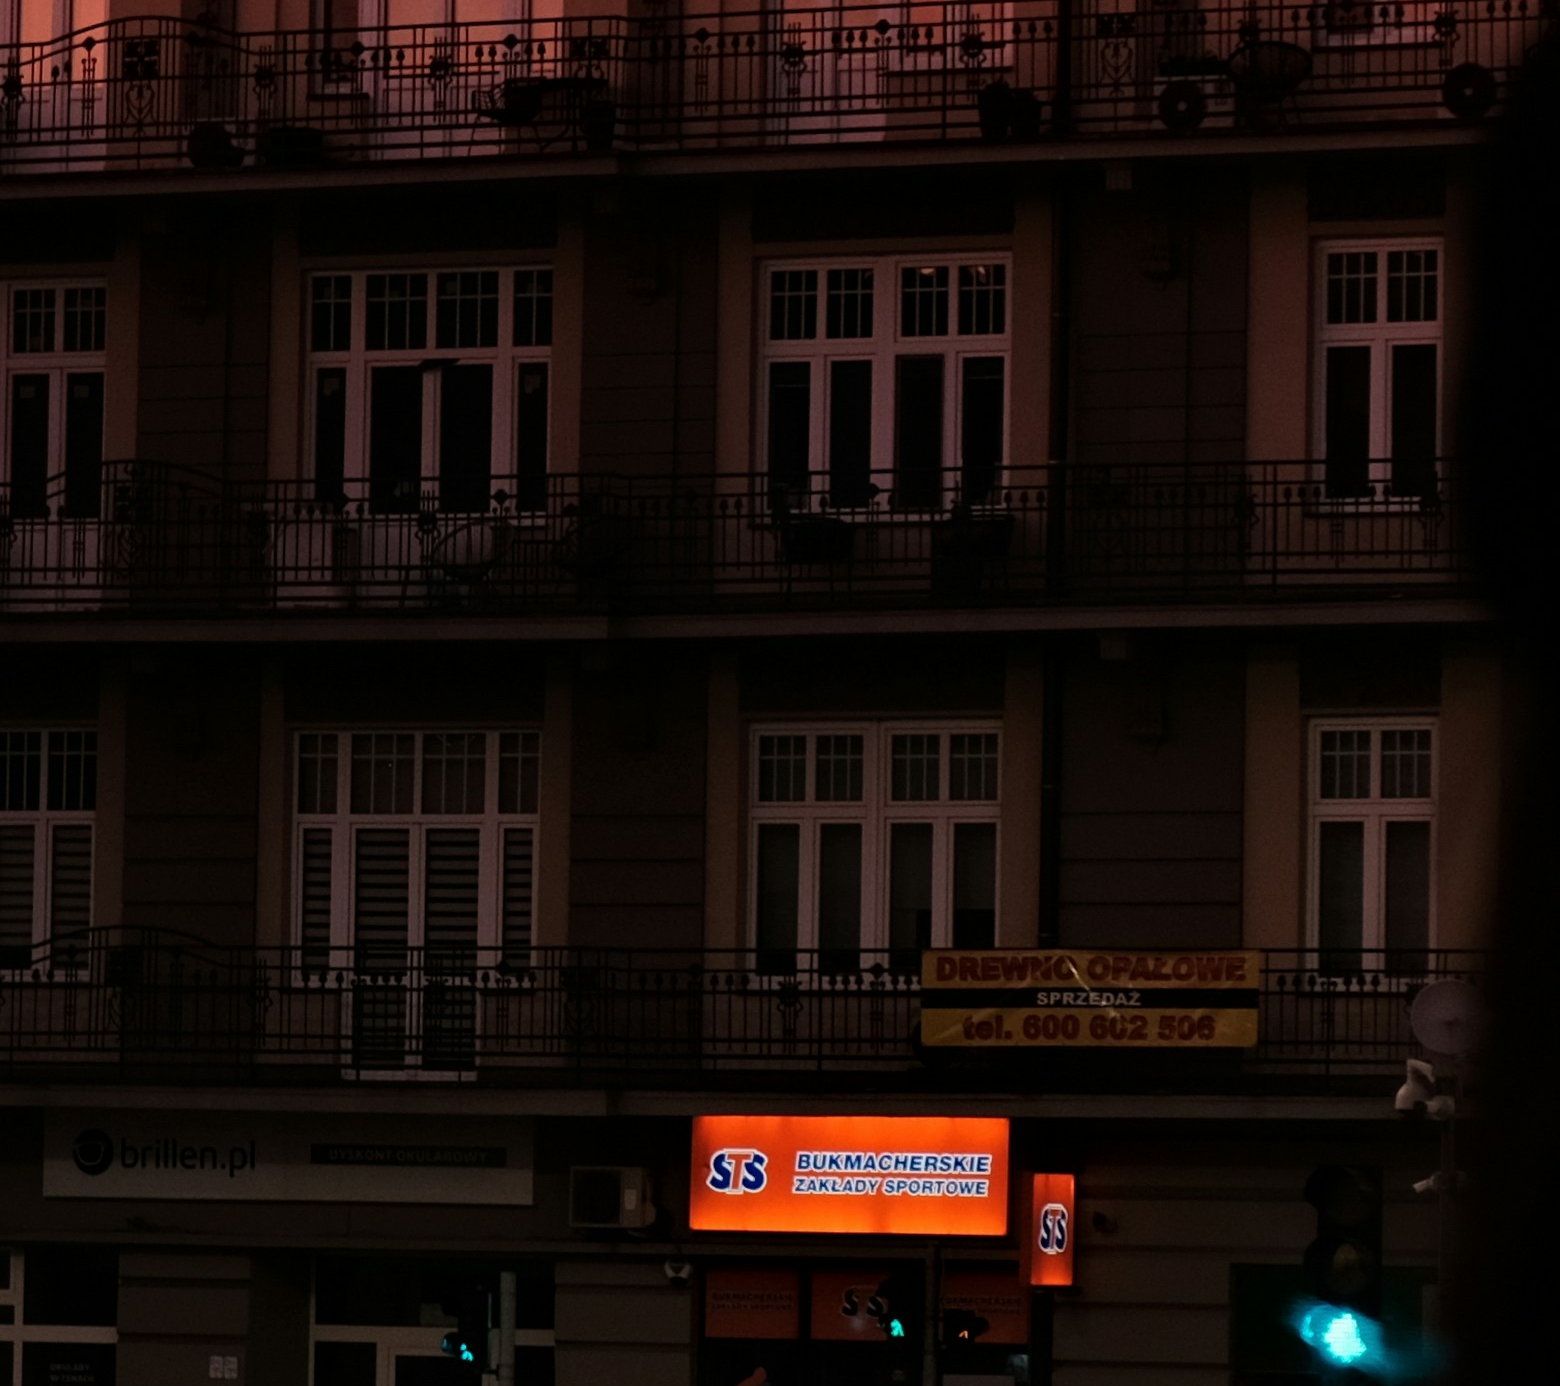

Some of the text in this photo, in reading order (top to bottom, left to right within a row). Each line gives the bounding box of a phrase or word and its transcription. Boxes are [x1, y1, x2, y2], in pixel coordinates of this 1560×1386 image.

[936, 955, 1247, 982] DREWNO OPAŁOWE
[1036, 991, 1142, 1006] SPRZEDAŻ
[963, 1014, 1216, 1041] tel. 600 602 506
[120, 1138, 256, 1177] brillen.pl
[706, 1147, 768, 1194] STS
[795, 1151, 992, 1173] BUKMACHERSKIE
[792, 1176, 988, 1196] ZAKŁADY SPORTOWE
[1038, 1203, 1068, 1254] STS
